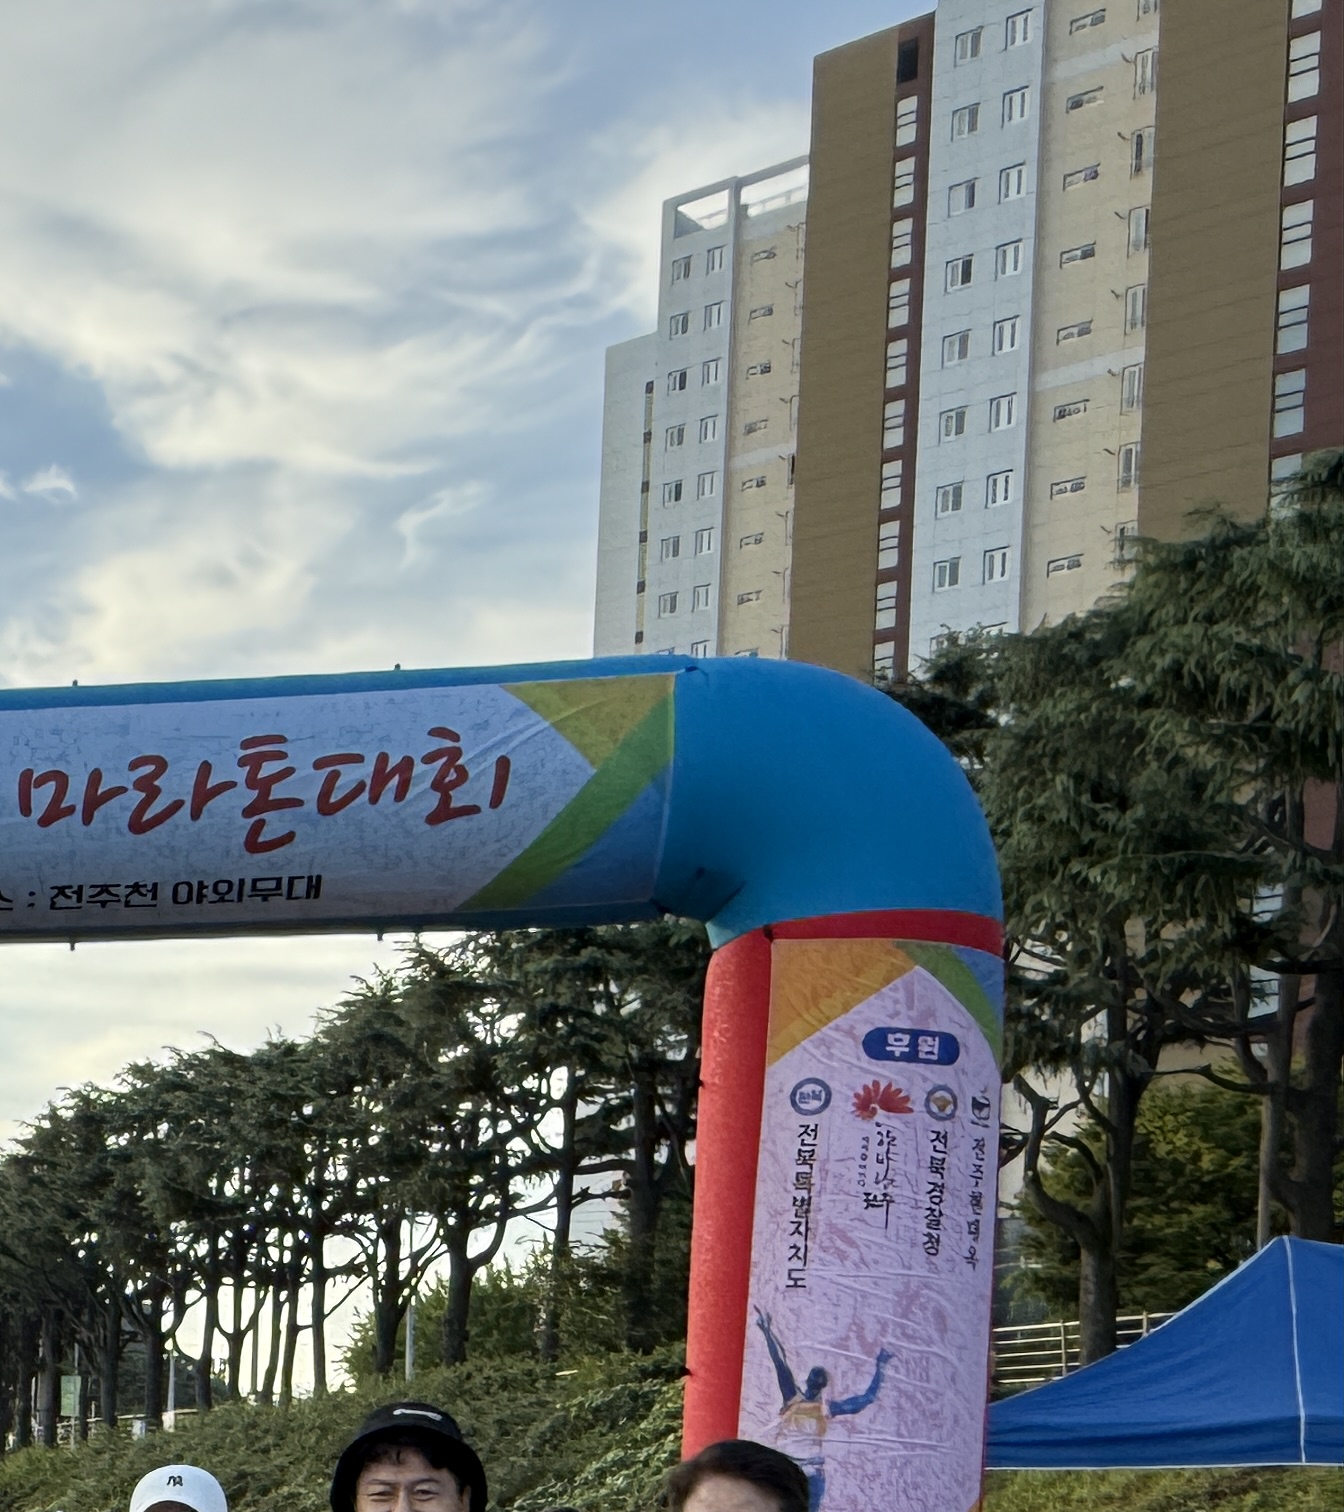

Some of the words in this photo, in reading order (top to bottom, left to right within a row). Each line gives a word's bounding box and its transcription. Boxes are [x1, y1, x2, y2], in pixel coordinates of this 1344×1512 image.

[17, 727, 511, 855] 마라톤대회
[49, 881, 159, 909] 전주천
[171, 874, 322, 905] 야외무대
[885, 1032, 940, 1061] 후원
[785, 1123, 819, 1289] 전북특별자치도
[922, 1129, 949, 1257] 전북경찰청
